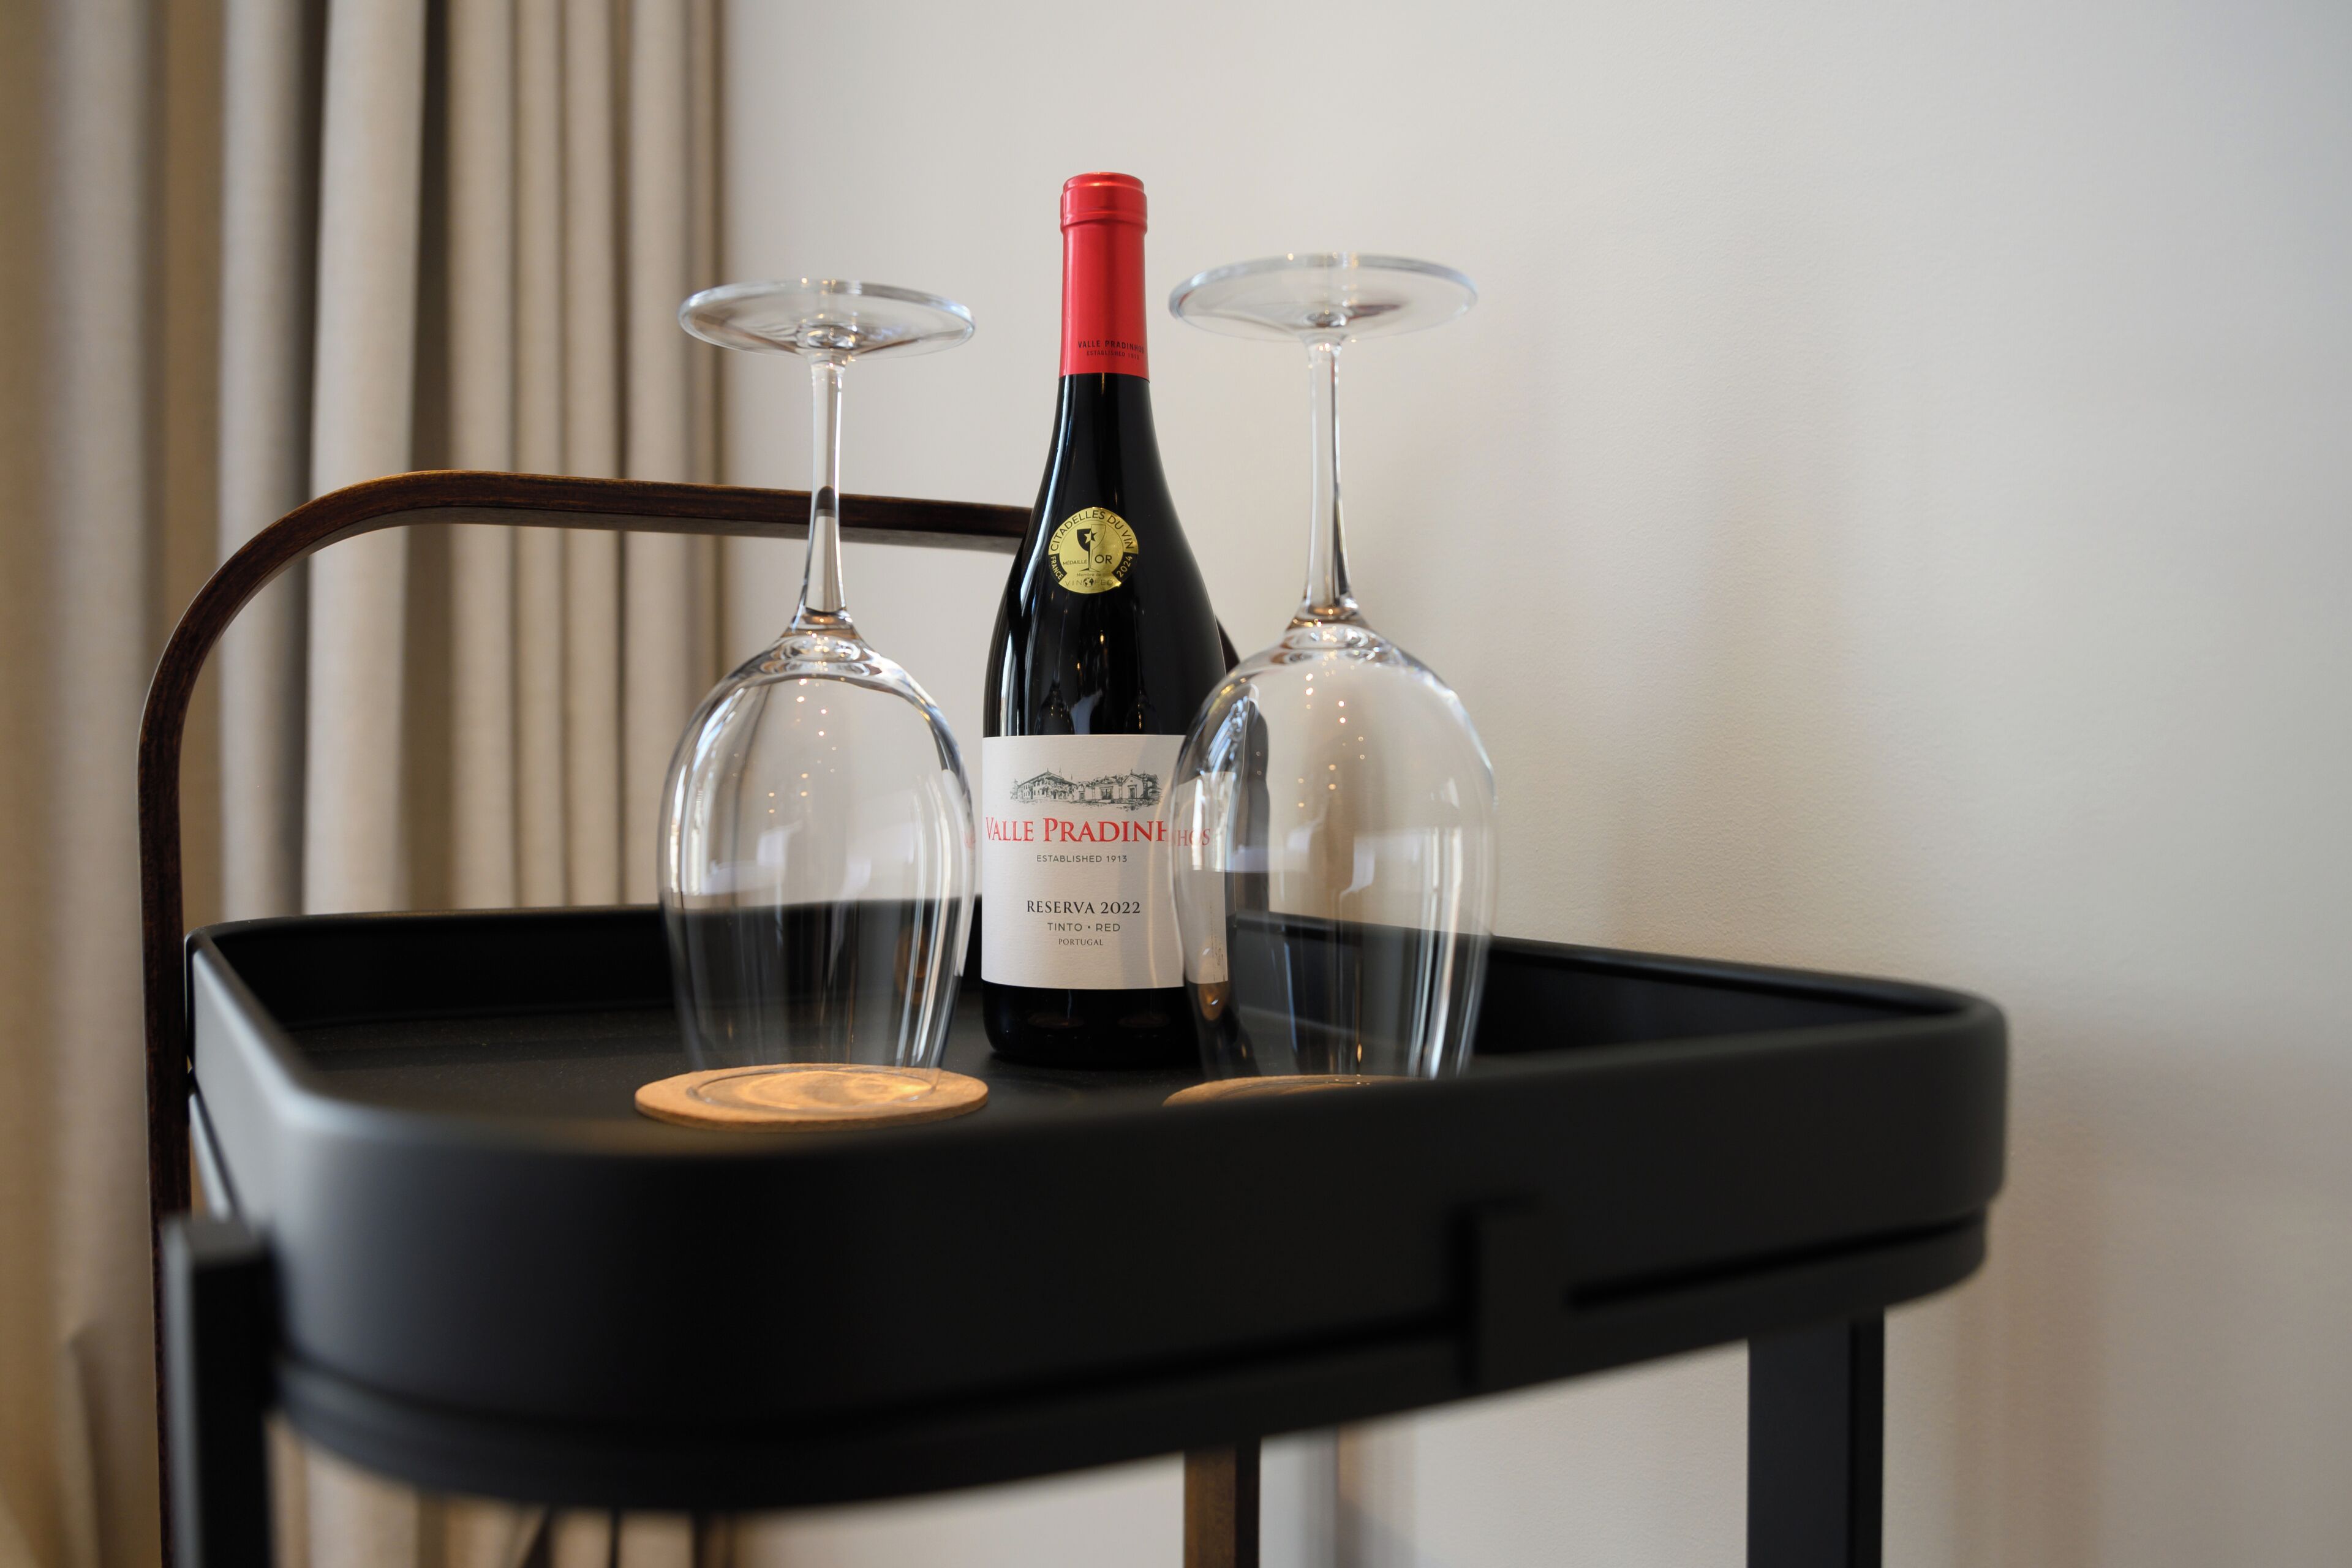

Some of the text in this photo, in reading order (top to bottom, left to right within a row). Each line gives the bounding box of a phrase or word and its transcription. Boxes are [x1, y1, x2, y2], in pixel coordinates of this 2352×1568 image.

[1105, 341, 1145, 354] PRADINHOS
[1050, 510, 1134, 551] CITADELLES DU VIN
[1050, 556, 1064, 580] FRANCE
[1095, 554, 1113, 565] OR
[1116, 555, 1133, 578] 2024
[986, 816, 1034, 842] VALLE
[1027, 900, 1140, 914] RESERVA 2022
[1047, 922, 1120, 932] TINTO RED
